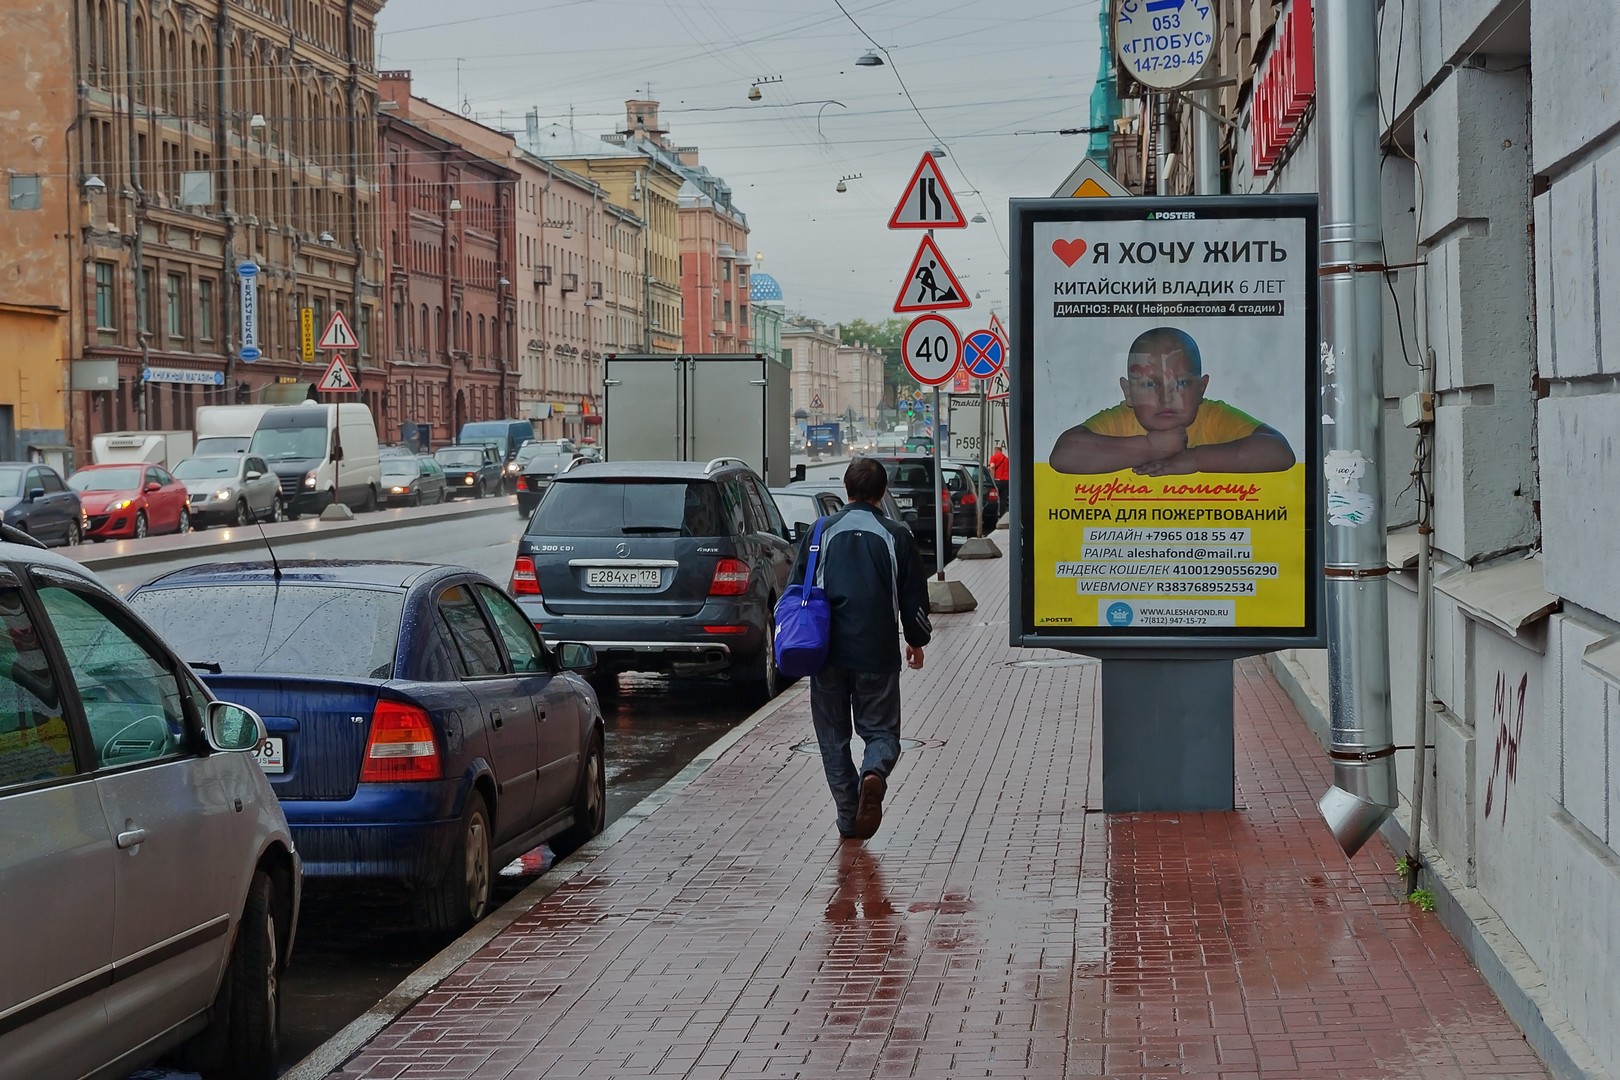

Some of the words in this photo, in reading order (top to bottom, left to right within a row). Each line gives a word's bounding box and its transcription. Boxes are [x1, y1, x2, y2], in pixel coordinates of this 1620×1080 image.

[1152, 14, 1181, 31] 053
[1122, 31, 1212, 54] «ГЛОБУС»
[1134, 50, 1204, 72] 147-29-45
[1156, 212, 1196, 220] POSTER
[1092, 242, 1110, 264] Я
[1118, 241, 1196, 264] ХОЧУ
[1203, 240, 1288, 263] ЖИТЬ
[1054, 278, 1156, 295] КИТАЙСКИЙ
[1162, 280, 1234, 297] ВЛАДИК
[1239, 280, 1248, 294] 6
[1253, 279, 1286, 294] ЛЕТ
[1056, 305, 1110, 316] ДИАГНОЗ:
[1113, 305, 1134, 314] РАК
[1142, 303, 1226, 316] Нейробластома
[1228, 304, 1236, 314] 4
[1238, 304, 1276, 314] стадии
[916, 336, 948, 362] 40
[1074, 478, 1153, 505] нужна
[1163, 480, 1261, 500] помощь
[1048, 508, 1112, 520] НОМЕРА
[1115, 508, 1147, 522] ДЛЯ
[1152, 506, 1288, 520] ПОЖЕРТВОВАНИЙ
[1090, 530, 1143, 541] БИЛАЙН
[1145, 531, 1182, 542] +7965
[1186, 531, 1208, 542] 018
[1211, 531, 1226, 542] 55
[1230, 531, 1244, 542] 47
[1084, 548, 1124, 558] PAIPAL
[1126, 548, 1250, 560] aleshafond@mail.ru
[590, 570, 637, 583] Е284ХР
[640, 570, 657, 581] 178
[1056, 564, 1106, 576] ЯНДЕКС
[1109, 564, 1170, 576] КОШЕЛЕК
[1172, 565, 1278, 576] 41001290556290
[1080, 581, 1154, 592] WEBMONEY
[1156, 582, 1254, 592] R383768952534
[1140, 617, 1168, 625] +7(812)
